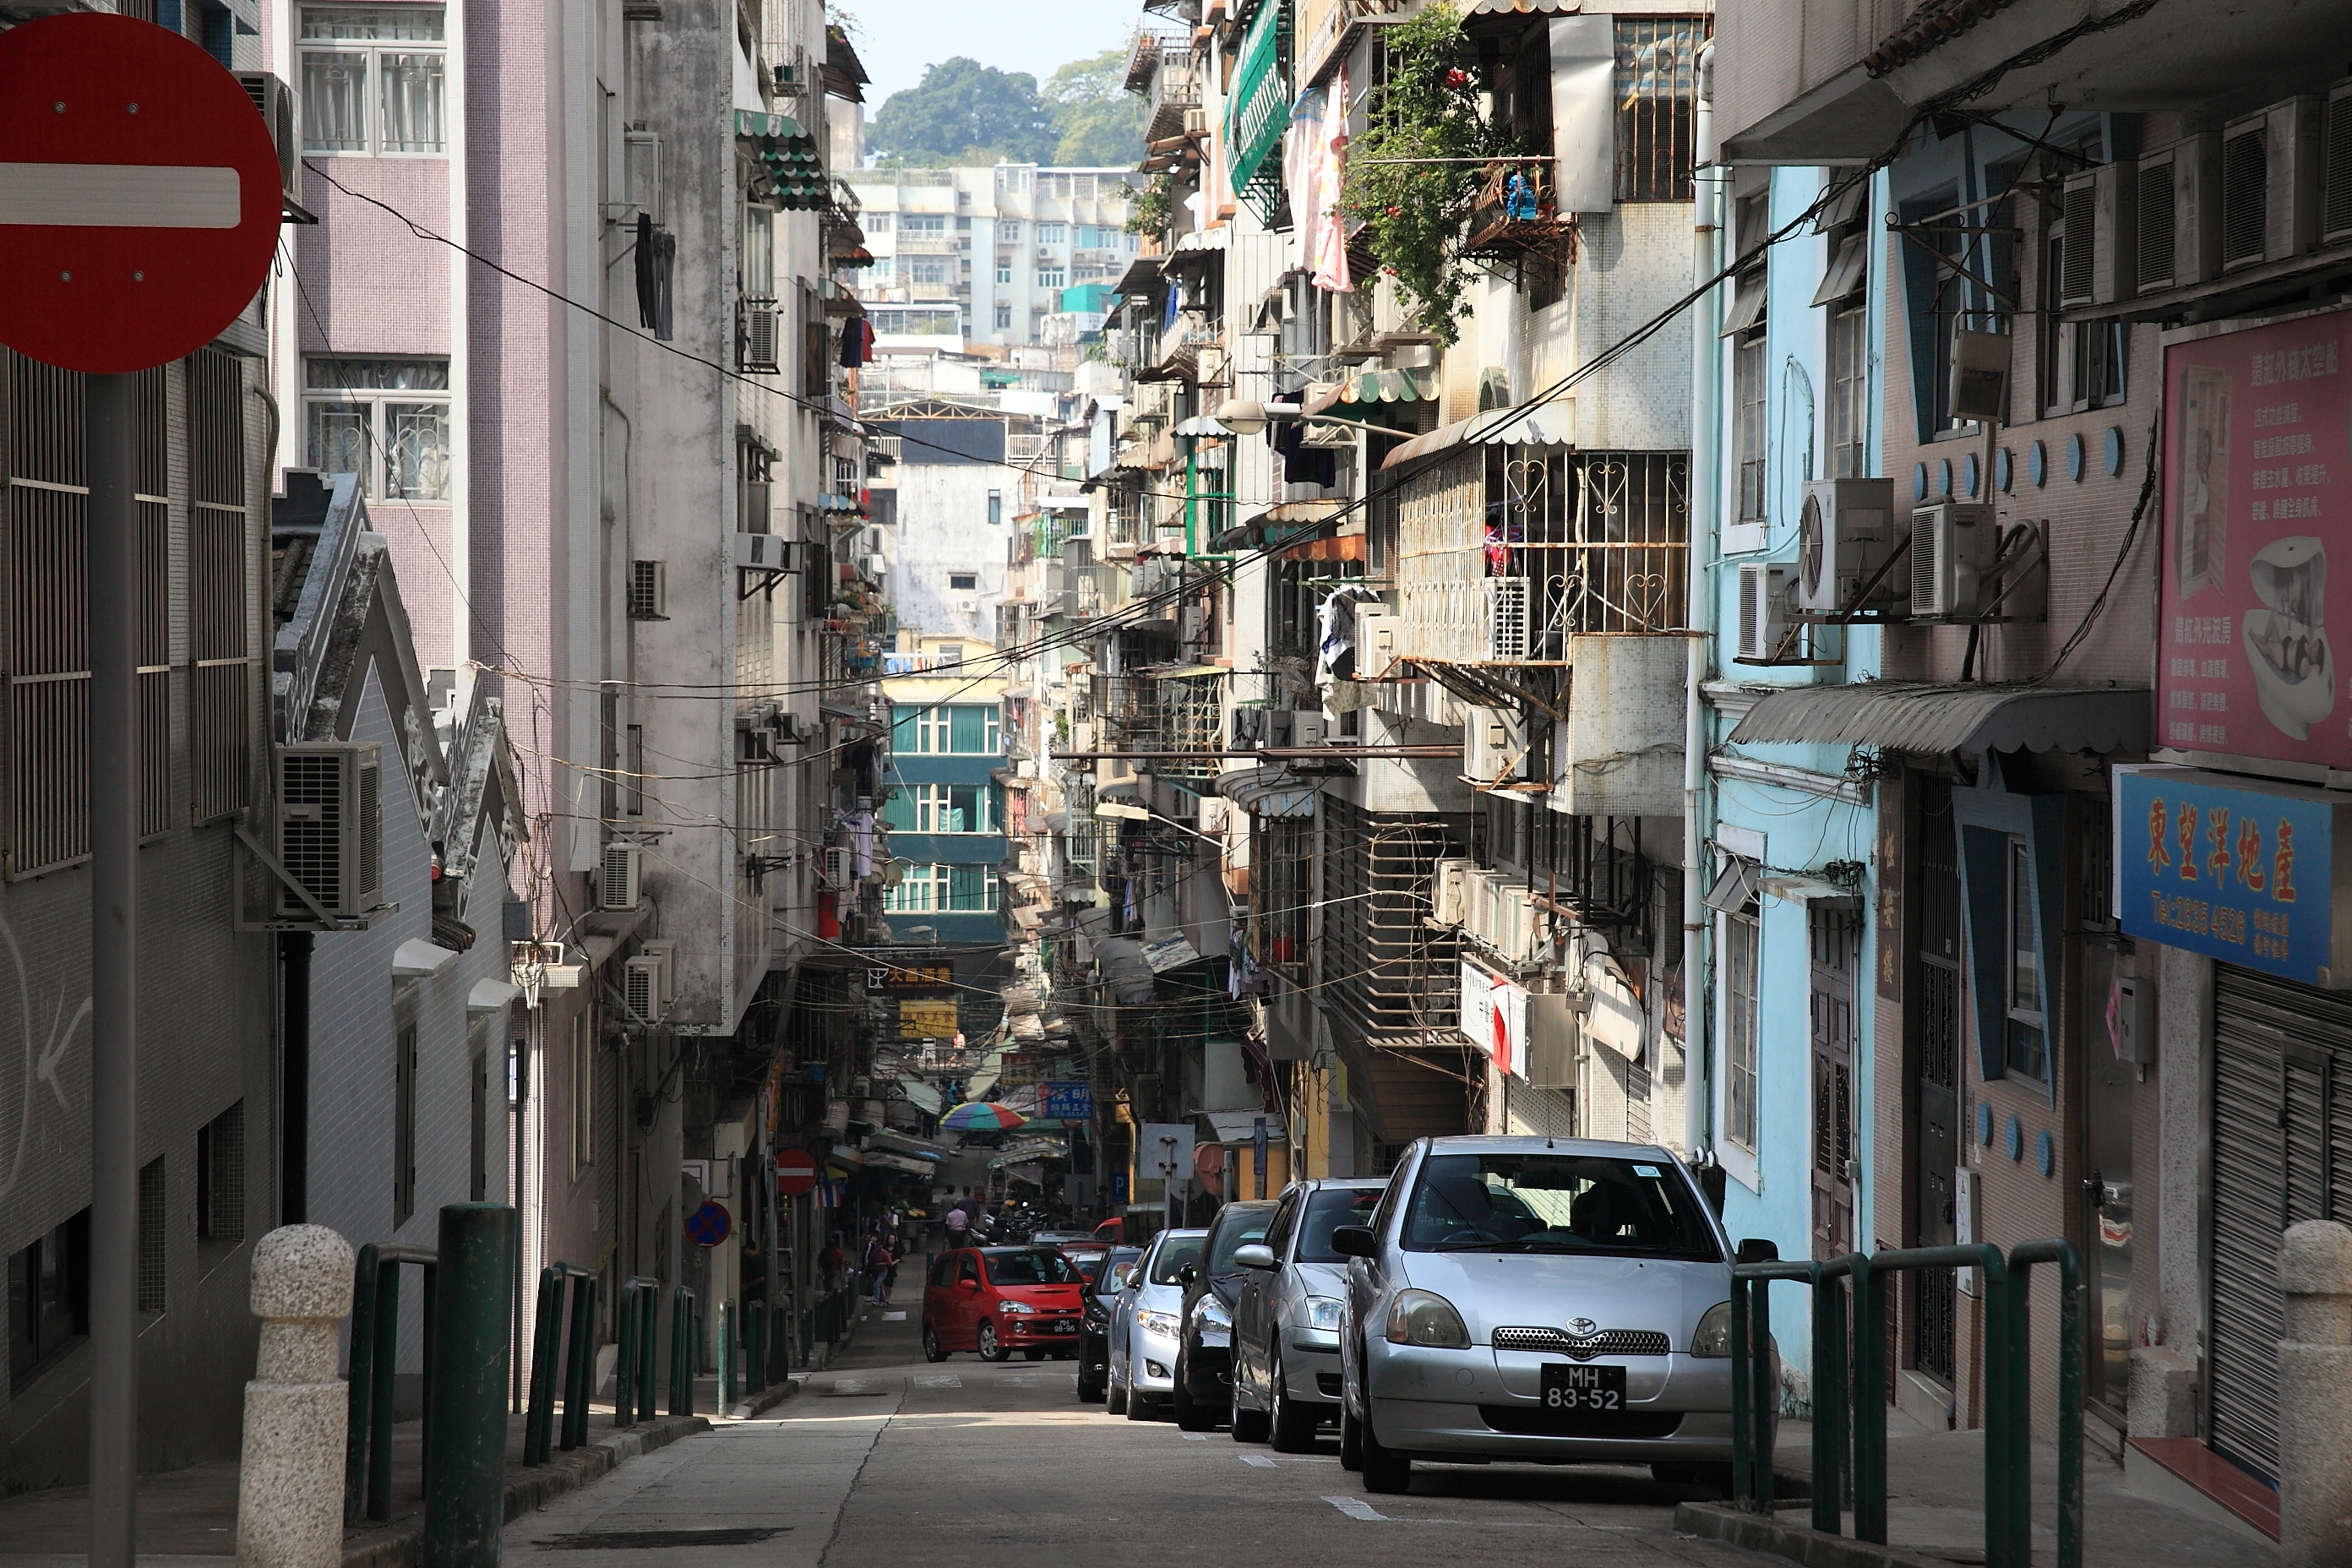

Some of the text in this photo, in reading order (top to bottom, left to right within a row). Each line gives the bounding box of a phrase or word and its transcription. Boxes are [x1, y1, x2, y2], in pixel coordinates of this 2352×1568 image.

[2174, 616, 2232, 645] 遠紅外光波房
[2148, 796, 2297, 903] 東望洋地產
[2211, 905, 2246, 945] 4526
[889, 967, 951, 983] 大昌酒業
[1116, 1176, 1124, 1195] P
[1569, 1367, 1599, 1388] MH
[1547, 1387, 1619, 1410] 83-52
